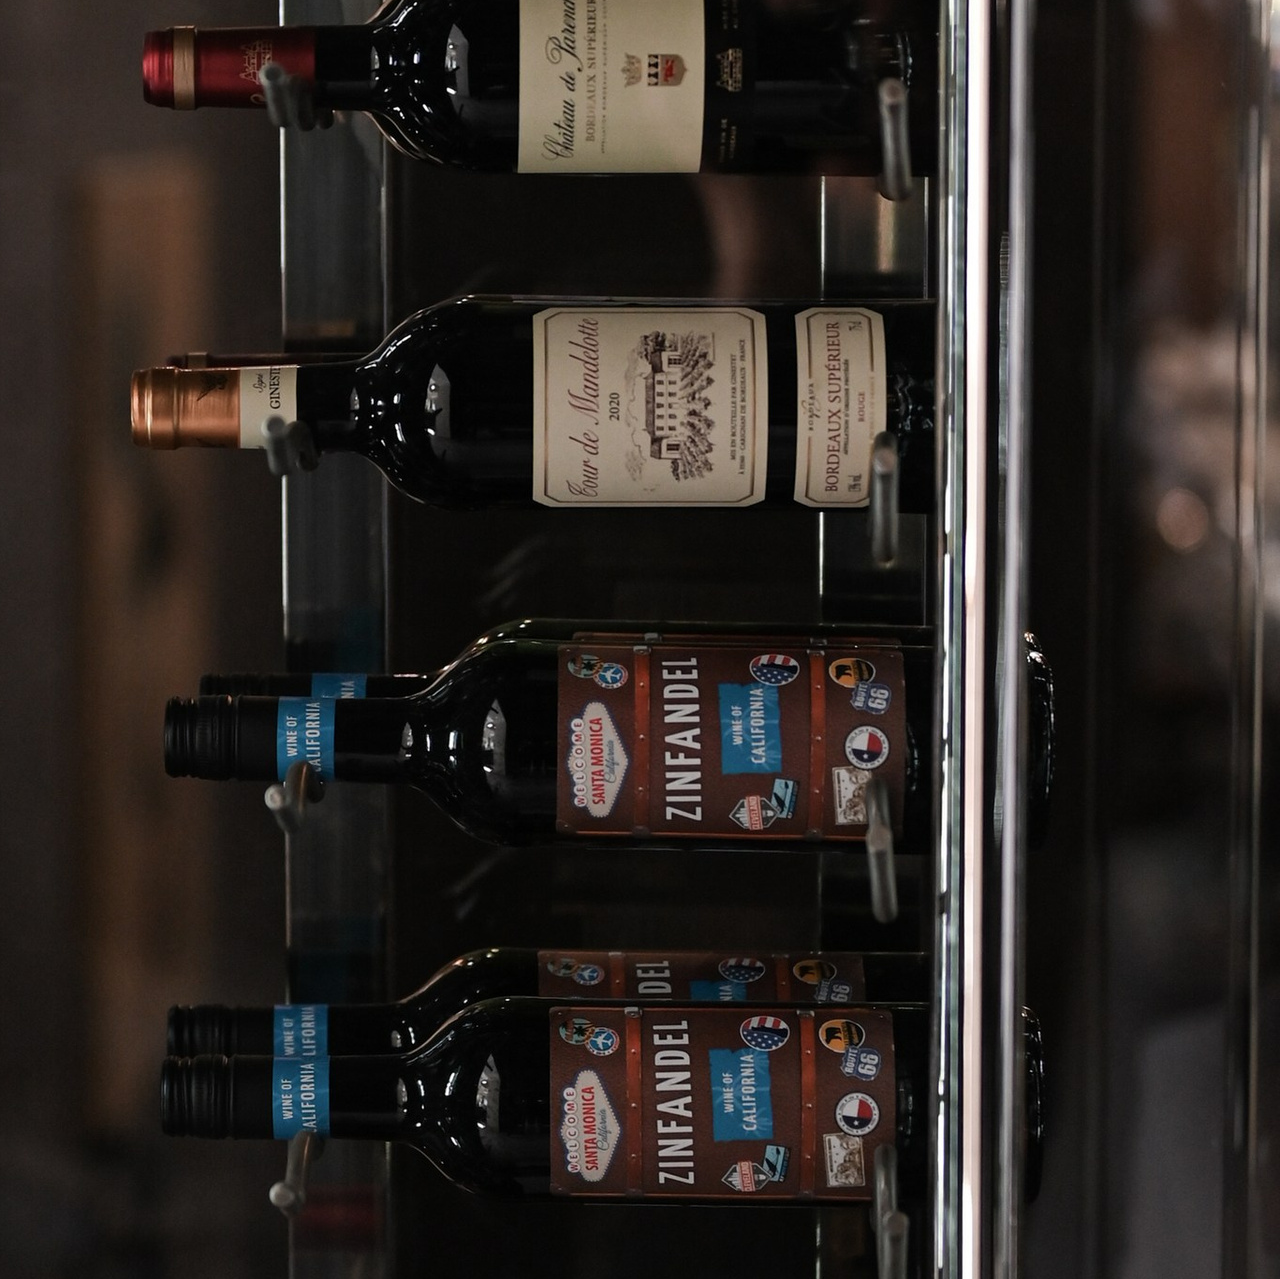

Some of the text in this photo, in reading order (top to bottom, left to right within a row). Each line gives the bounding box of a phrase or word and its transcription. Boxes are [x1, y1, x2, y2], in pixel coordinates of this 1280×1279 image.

[558, 70, 577, 93] de
[585, 73, 597, 142] BORDEAUX
[540, 98, 577, 161] Château
[565, 317, 601, 498] Tour de Mandelotte
[608, 391, 620, 422] 2020
[824, 321, 842, 493] BORDEAUX SUPÉRIEUR
[857, 391, 866, 423] ROUGE
[854, 682, 868, 707] ROUTE
[869, 687, 890, 709] 66
[285, 715, 298, 757] WINE OF
[304, 701, 322, 772] ALIFORNIA
[661, 656, 703, 823] ZINFANDEL
[731, 705, 745, 746] WINE OF
[749, 687, 767, 765] CALIFORNIA
[570, 717, 588, 807] WELCOME
[588, 717, 606, 806] SANTA MONICA
[603, 739, 617, 784] California
[748, 795, 762, 831] CLEVELAND
[830, 984, 850, 1002] 66
[283, 1017, 295, 1056] WINE OF
[844, 1047, 858, 1074] ROUTE
[857, 1053, 879, 1075] 66
[281, 1078, 294, 1120] WINE OF
[652, 1020, 695, 1186] ZINFANDEL
[722, 1072, 735, 1114] WINE OF
[739, 1053, 758, 1132] CALIFORNIA
[561, 1086, 580, 1173] WELCOME
[580, 1086, 599, 1172] SANTA MONICA
[595, 1108, 609, 1152] California
[740, 1160, 753, 1192] CLEVELAND
